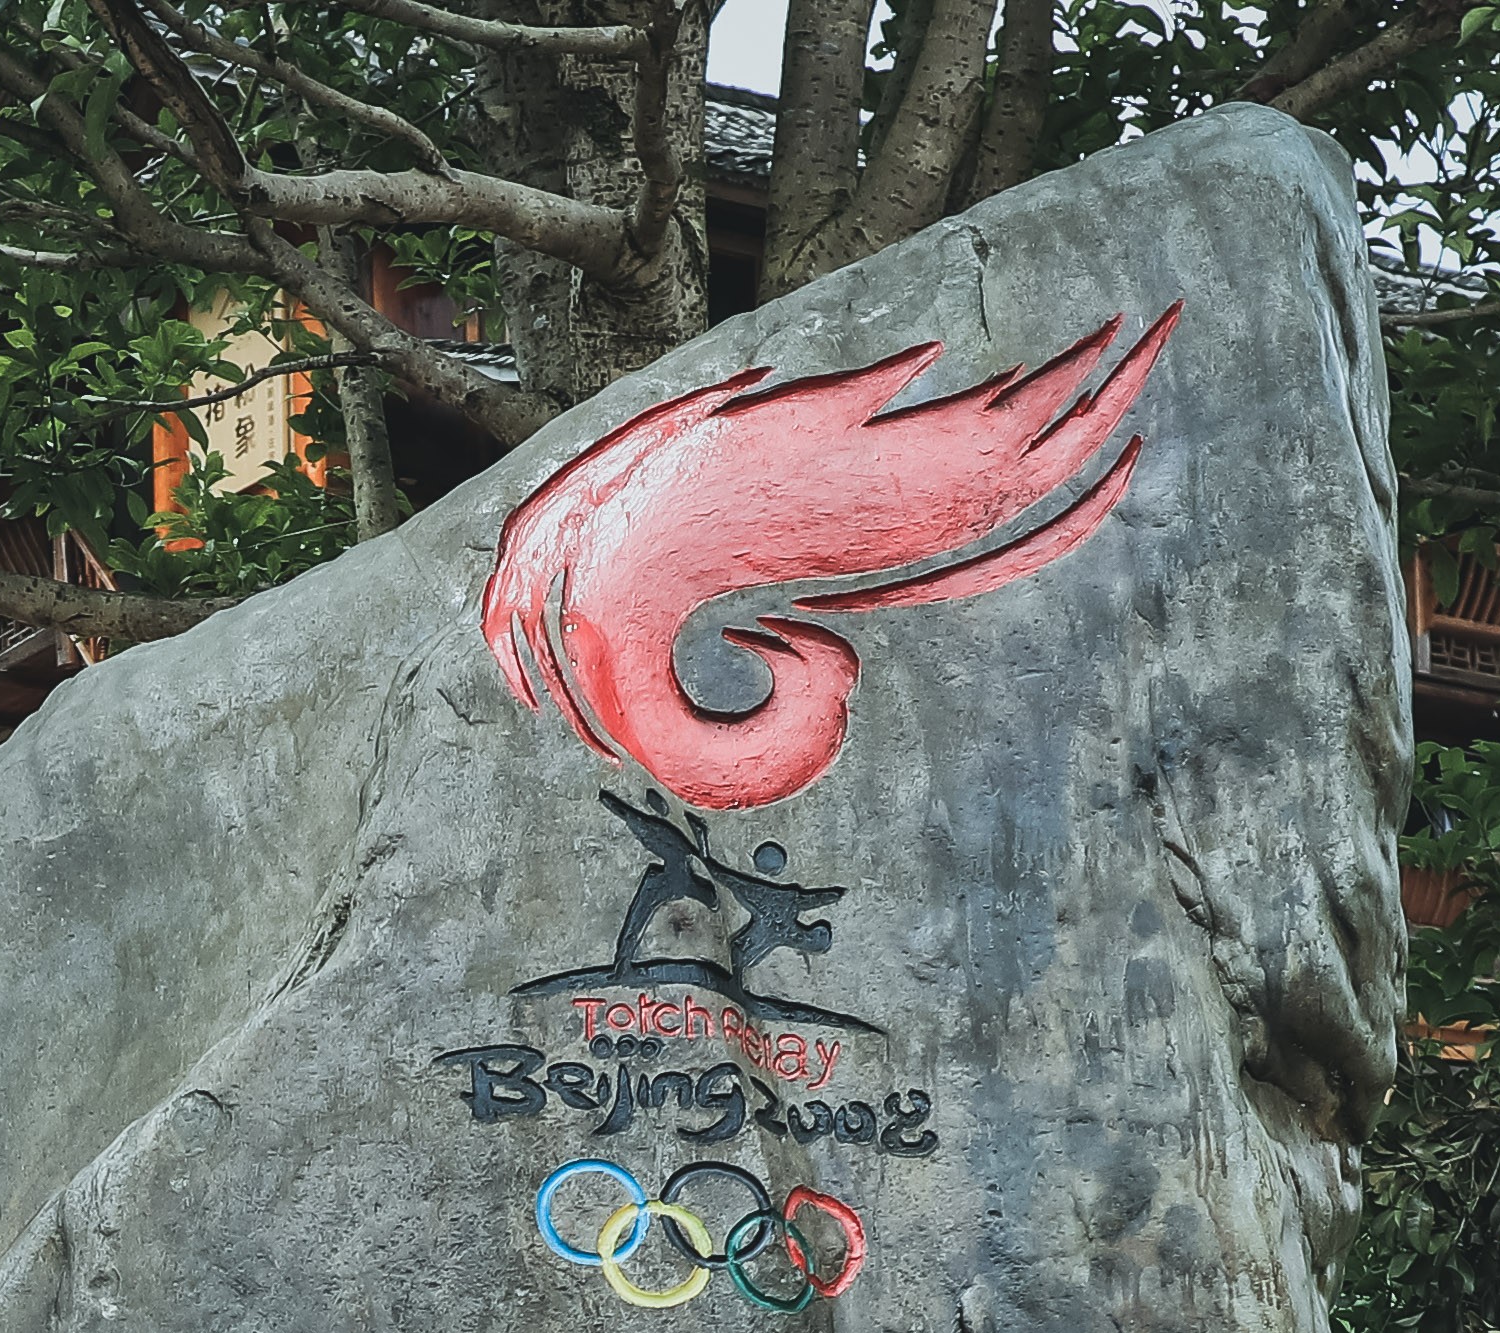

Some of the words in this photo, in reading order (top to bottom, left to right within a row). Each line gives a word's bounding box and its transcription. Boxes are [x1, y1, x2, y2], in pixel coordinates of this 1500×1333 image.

[430, 1034, 746, 1145] Beijing
[750, 1074, 939, 1157] 2008
[720, 1006, 841, 1091] Relay
